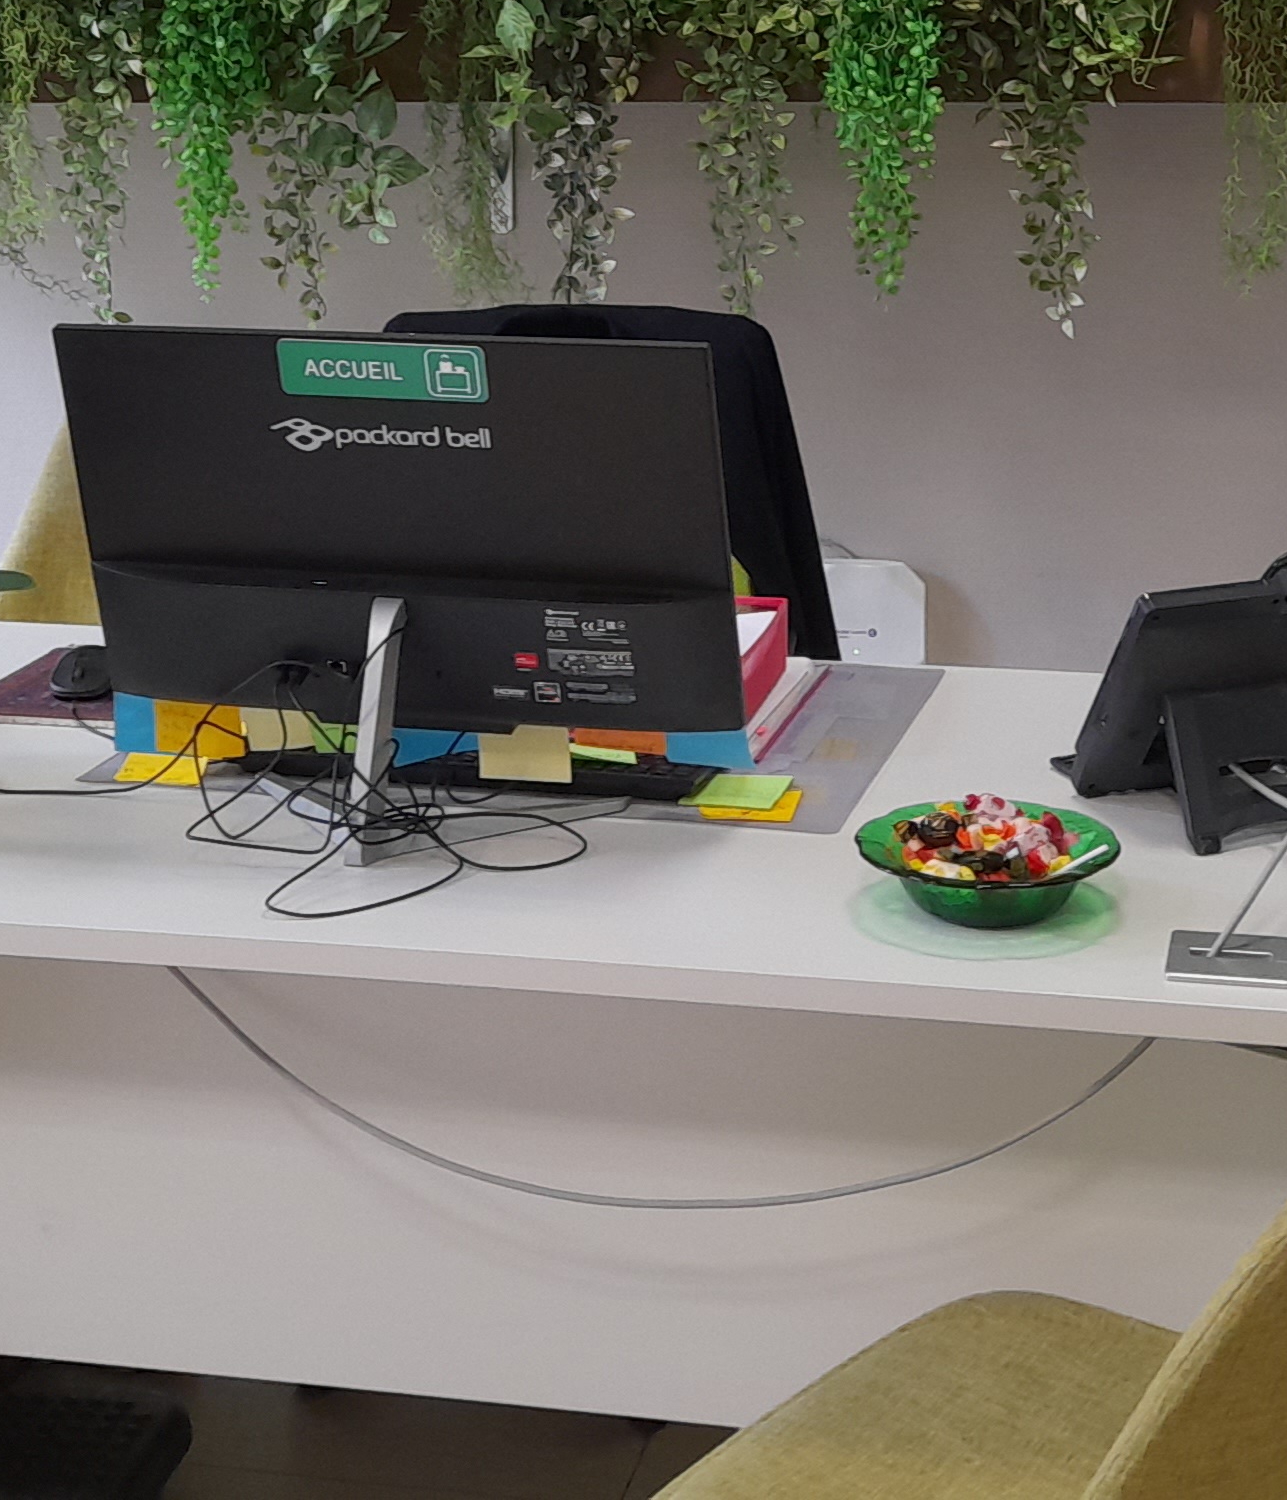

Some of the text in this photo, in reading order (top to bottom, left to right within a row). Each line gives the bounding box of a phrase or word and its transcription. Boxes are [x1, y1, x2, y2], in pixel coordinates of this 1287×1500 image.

[304, 358, 404, 382] ACCUEIL
[335, 423, 492, 449] packard bell
